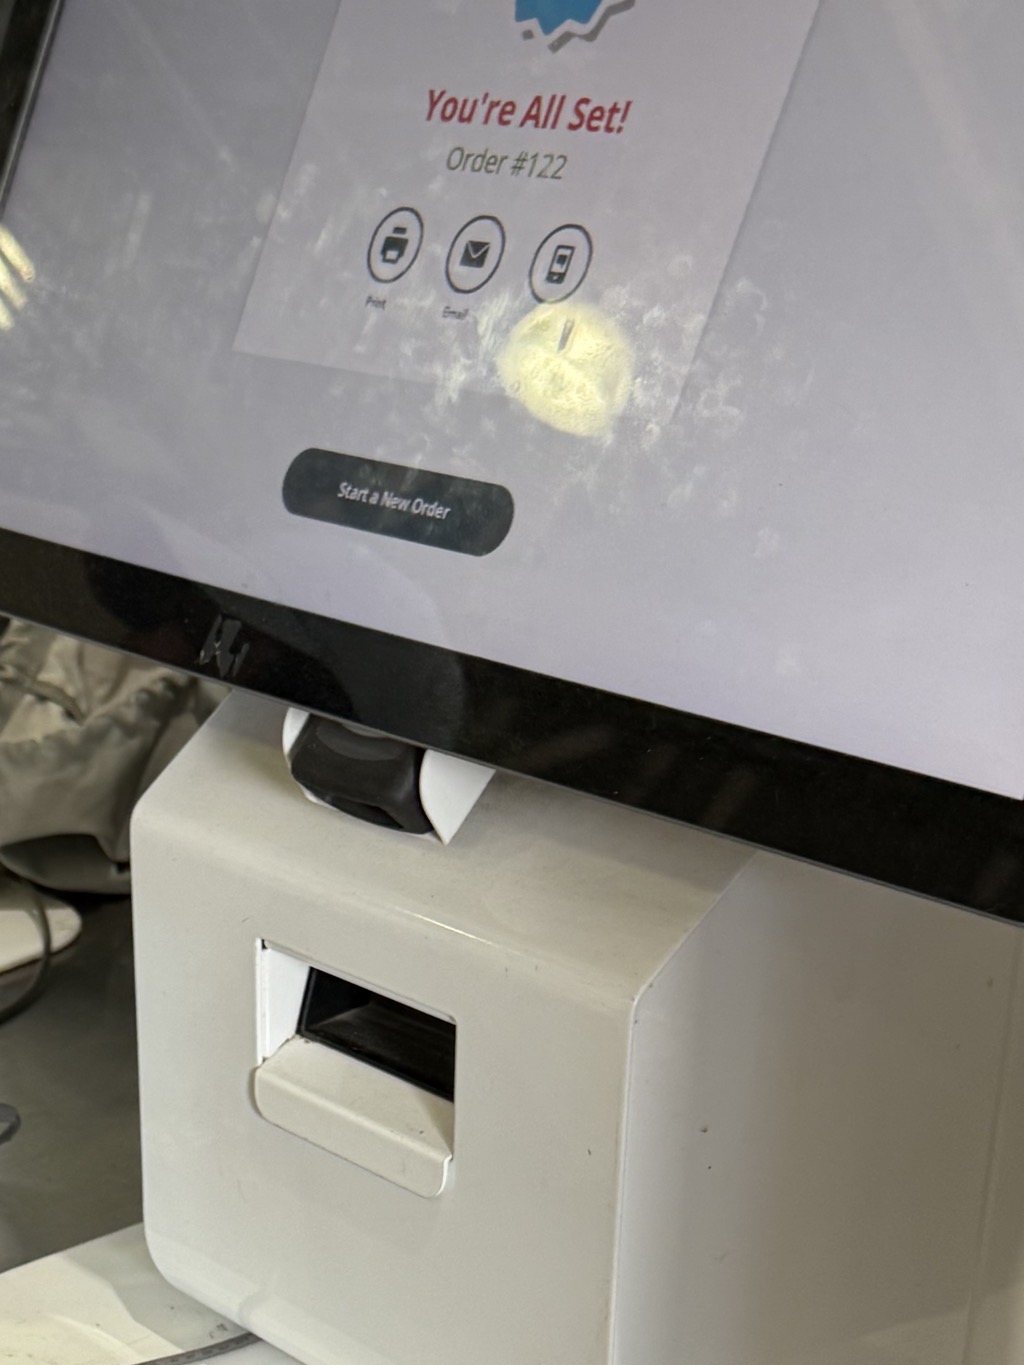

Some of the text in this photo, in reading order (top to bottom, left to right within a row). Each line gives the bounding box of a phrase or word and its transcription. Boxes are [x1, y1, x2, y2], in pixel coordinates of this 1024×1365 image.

[425, 89, 633, 134] You're All Set!
[446, 146, 569, 180] Order #122
[337, 482, 451, 520] Start a New Order
